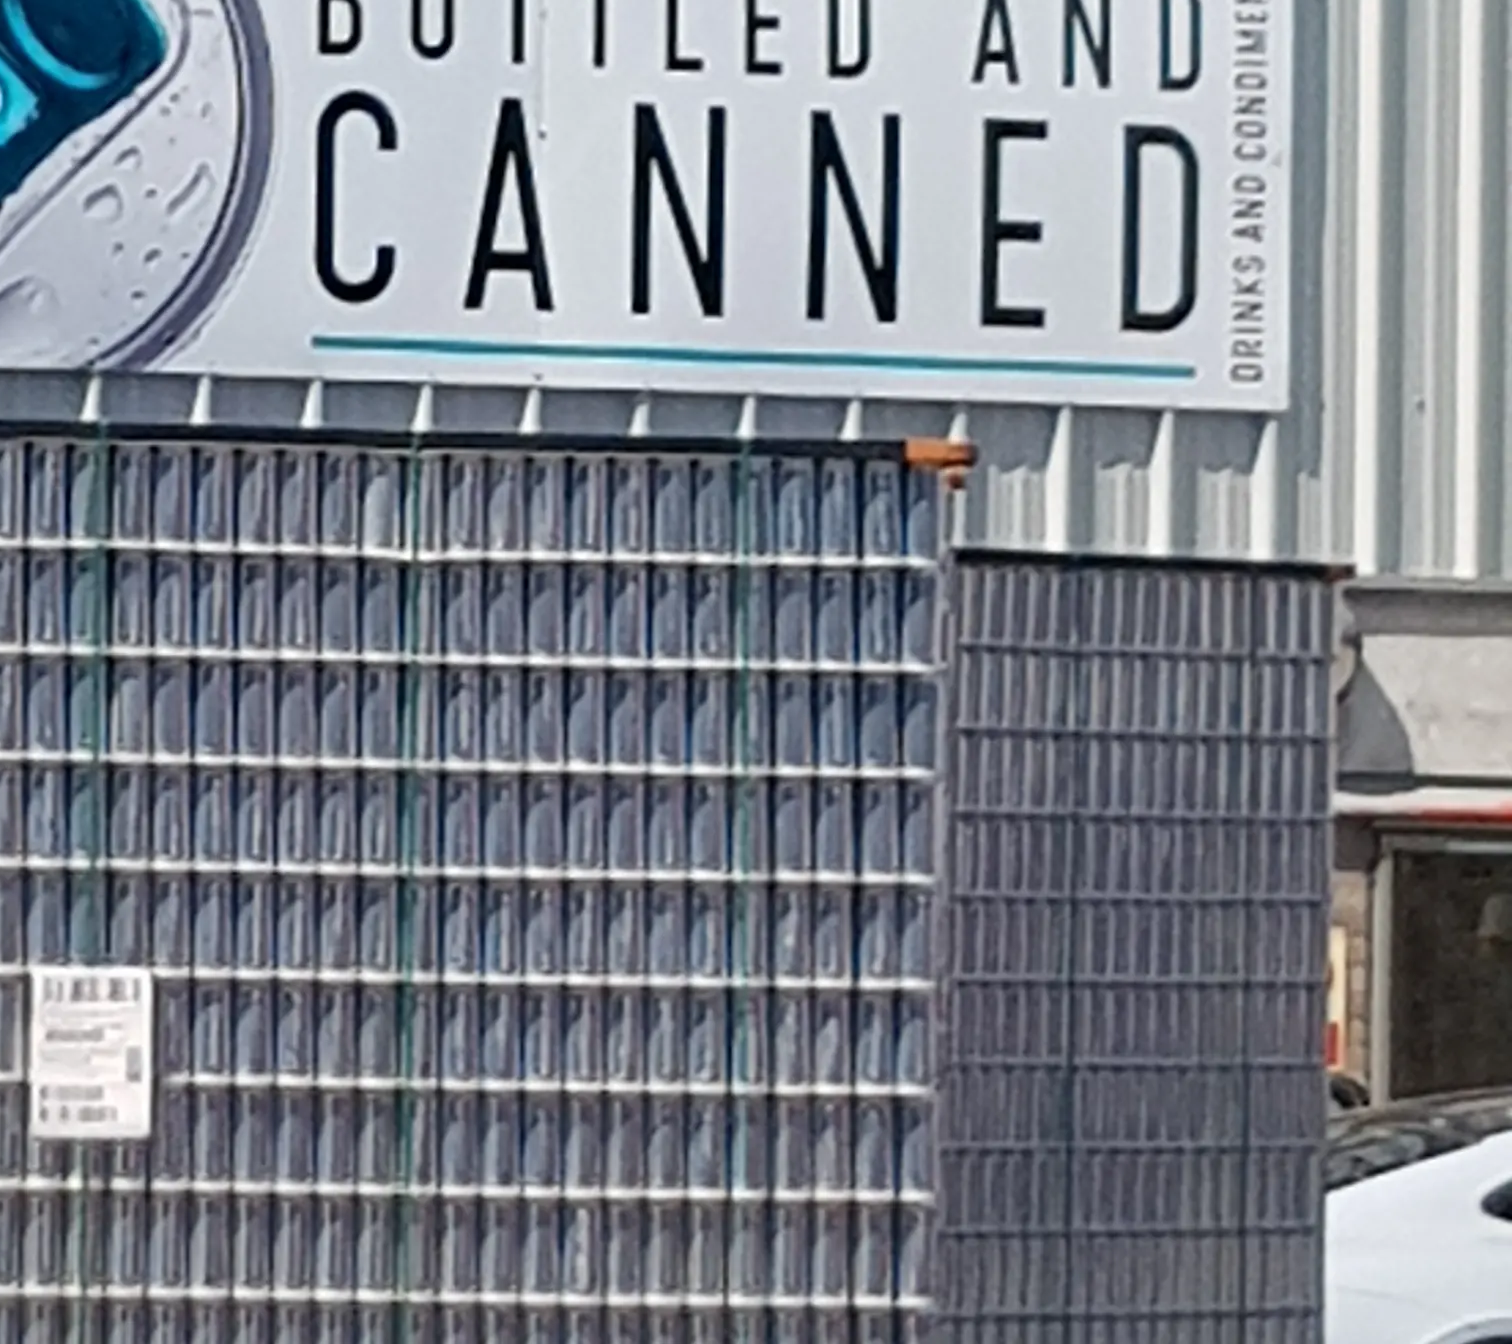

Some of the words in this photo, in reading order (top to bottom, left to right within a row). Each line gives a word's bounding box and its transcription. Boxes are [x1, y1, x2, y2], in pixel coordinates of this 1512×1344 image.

[315, 89, 1200, 334] CANNED
[1232, 175, 1266, 243] AND
[1230, 255, 1266, 383] DRINKS
